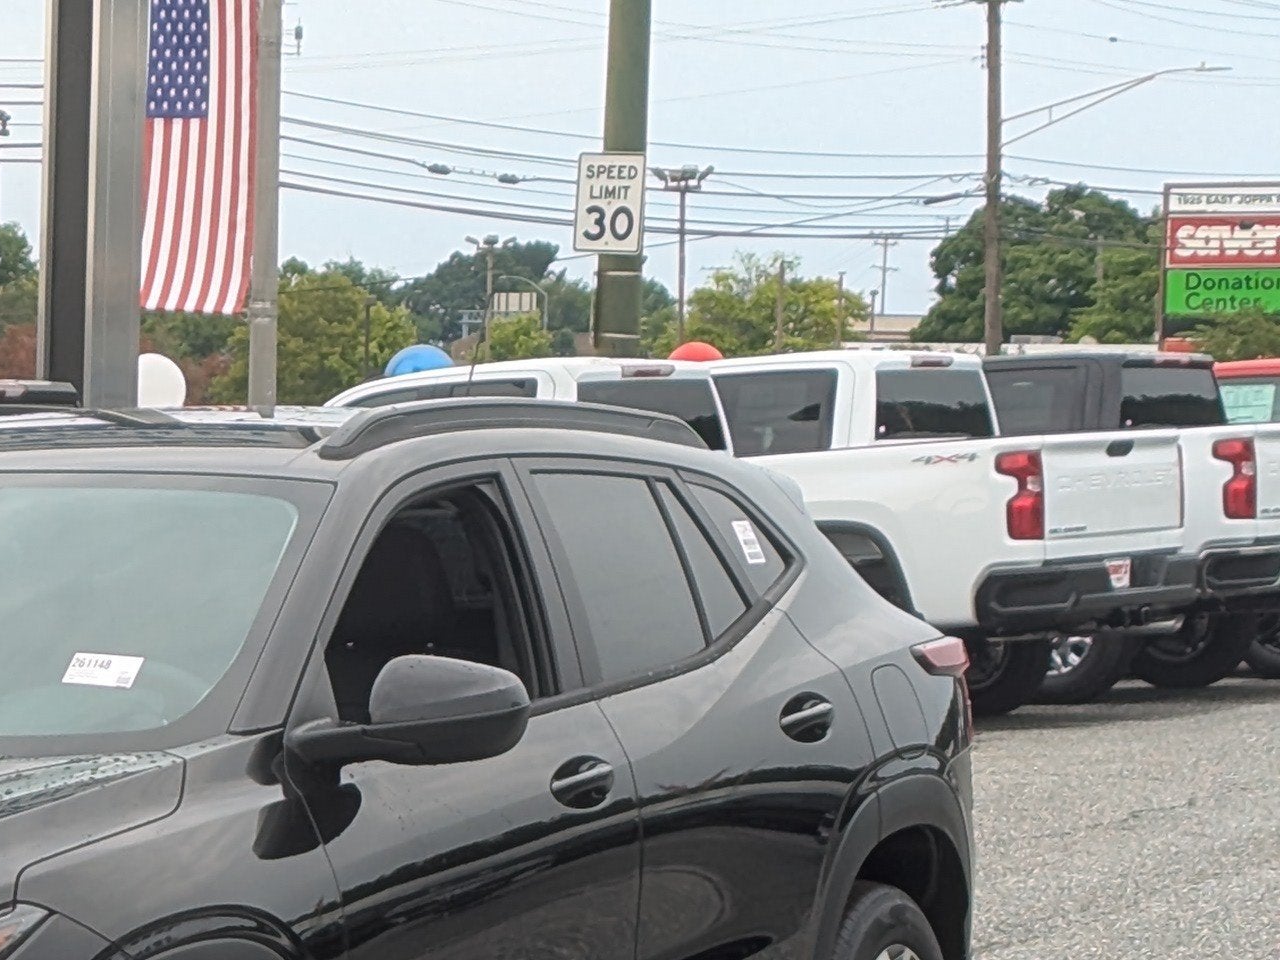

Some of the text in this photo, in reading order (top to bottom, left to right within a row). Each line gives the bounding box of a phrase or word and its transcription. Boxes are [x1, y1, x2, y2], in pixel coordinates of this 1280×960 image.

[586, 164, 638, 180] SPEED
[589, 184, 631, 200] LIMIT
[1206, 193, 1233, 204] EAST
[582, 205, 634, 241] 30
[1184, 292, 1262, 310] Center
